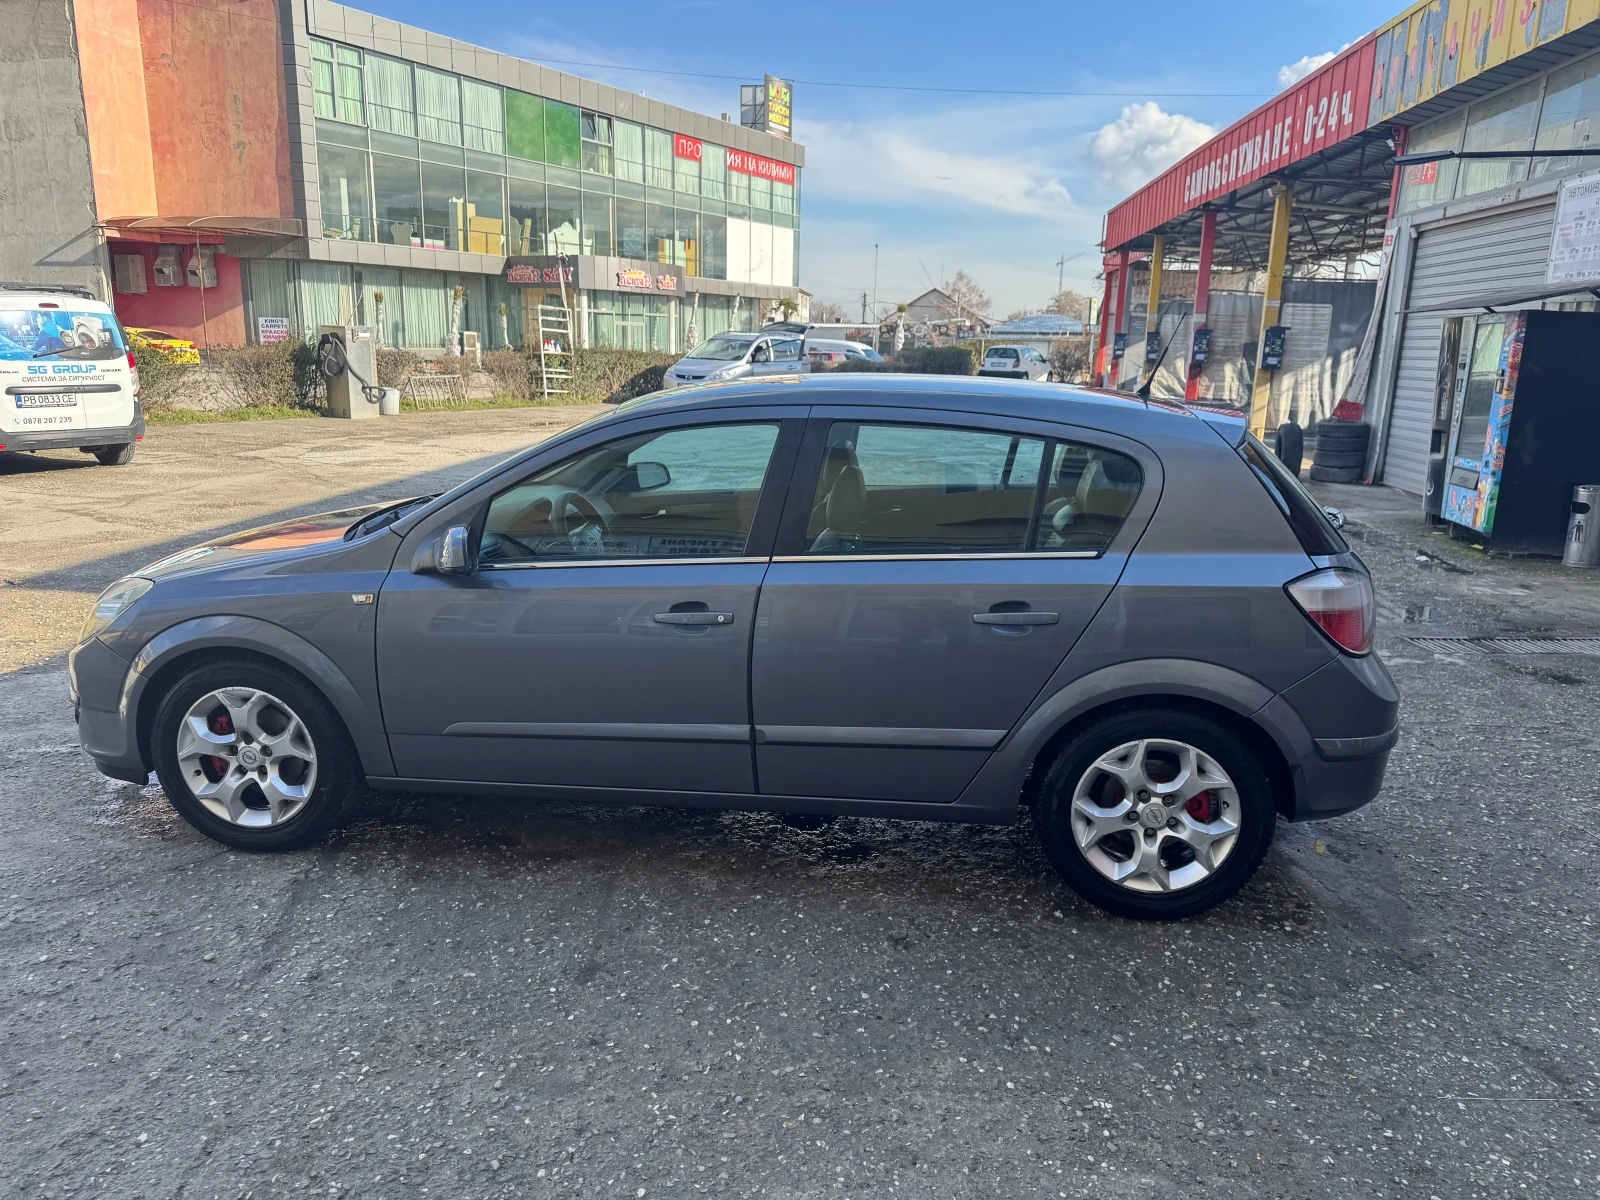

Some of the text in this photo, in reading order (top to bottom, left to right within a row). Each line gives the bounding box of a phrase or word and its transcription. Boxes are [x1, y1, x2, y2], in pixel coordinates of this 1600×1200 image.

[744, 156, 756, 172] НА
[758, 160, 792, 181] КИЛИМИ
[28, 366, 48, 374] SG
[52, 364, 97, 374] GROUP
[38, 394, 61, 403] 0833
[23, 417, 42, 425] 0878
[44, 416, 57, 424] 207
